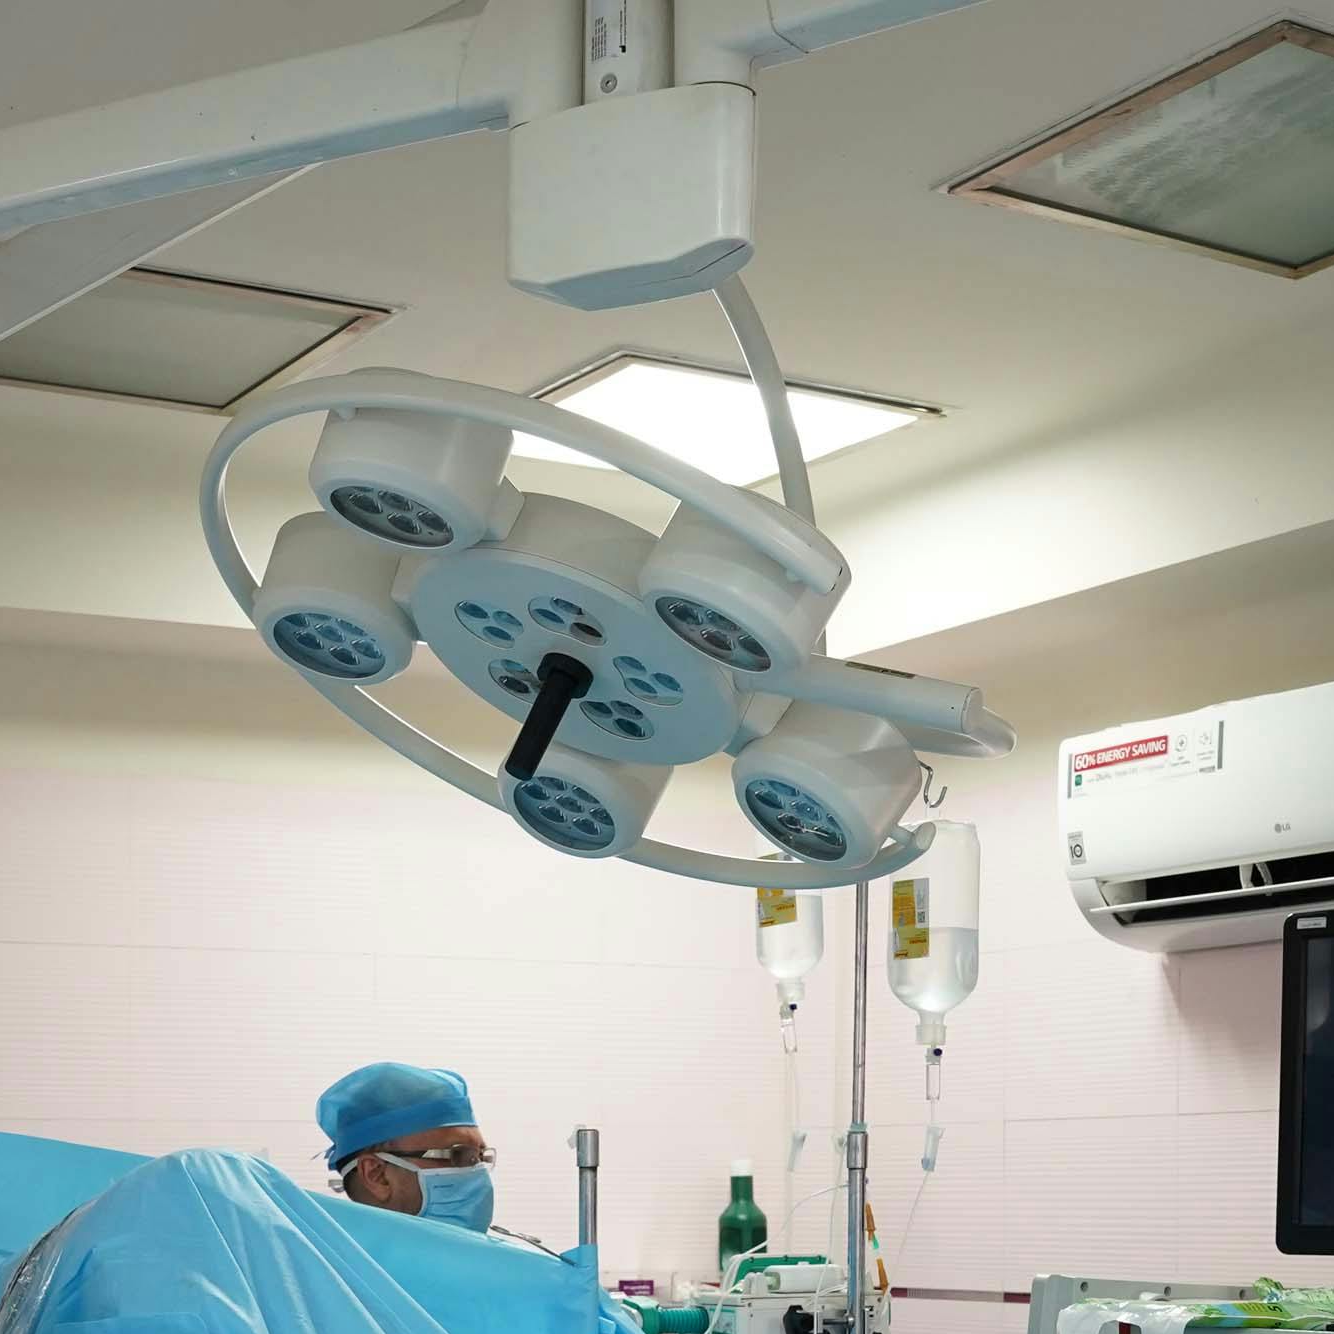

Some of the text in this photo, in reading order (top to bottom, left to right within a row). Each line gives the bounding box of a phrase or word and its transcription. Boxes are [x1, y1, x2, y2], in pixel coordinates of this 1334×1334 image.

[1075, 739, 1166, 770] 60% ENERGY SAVING
